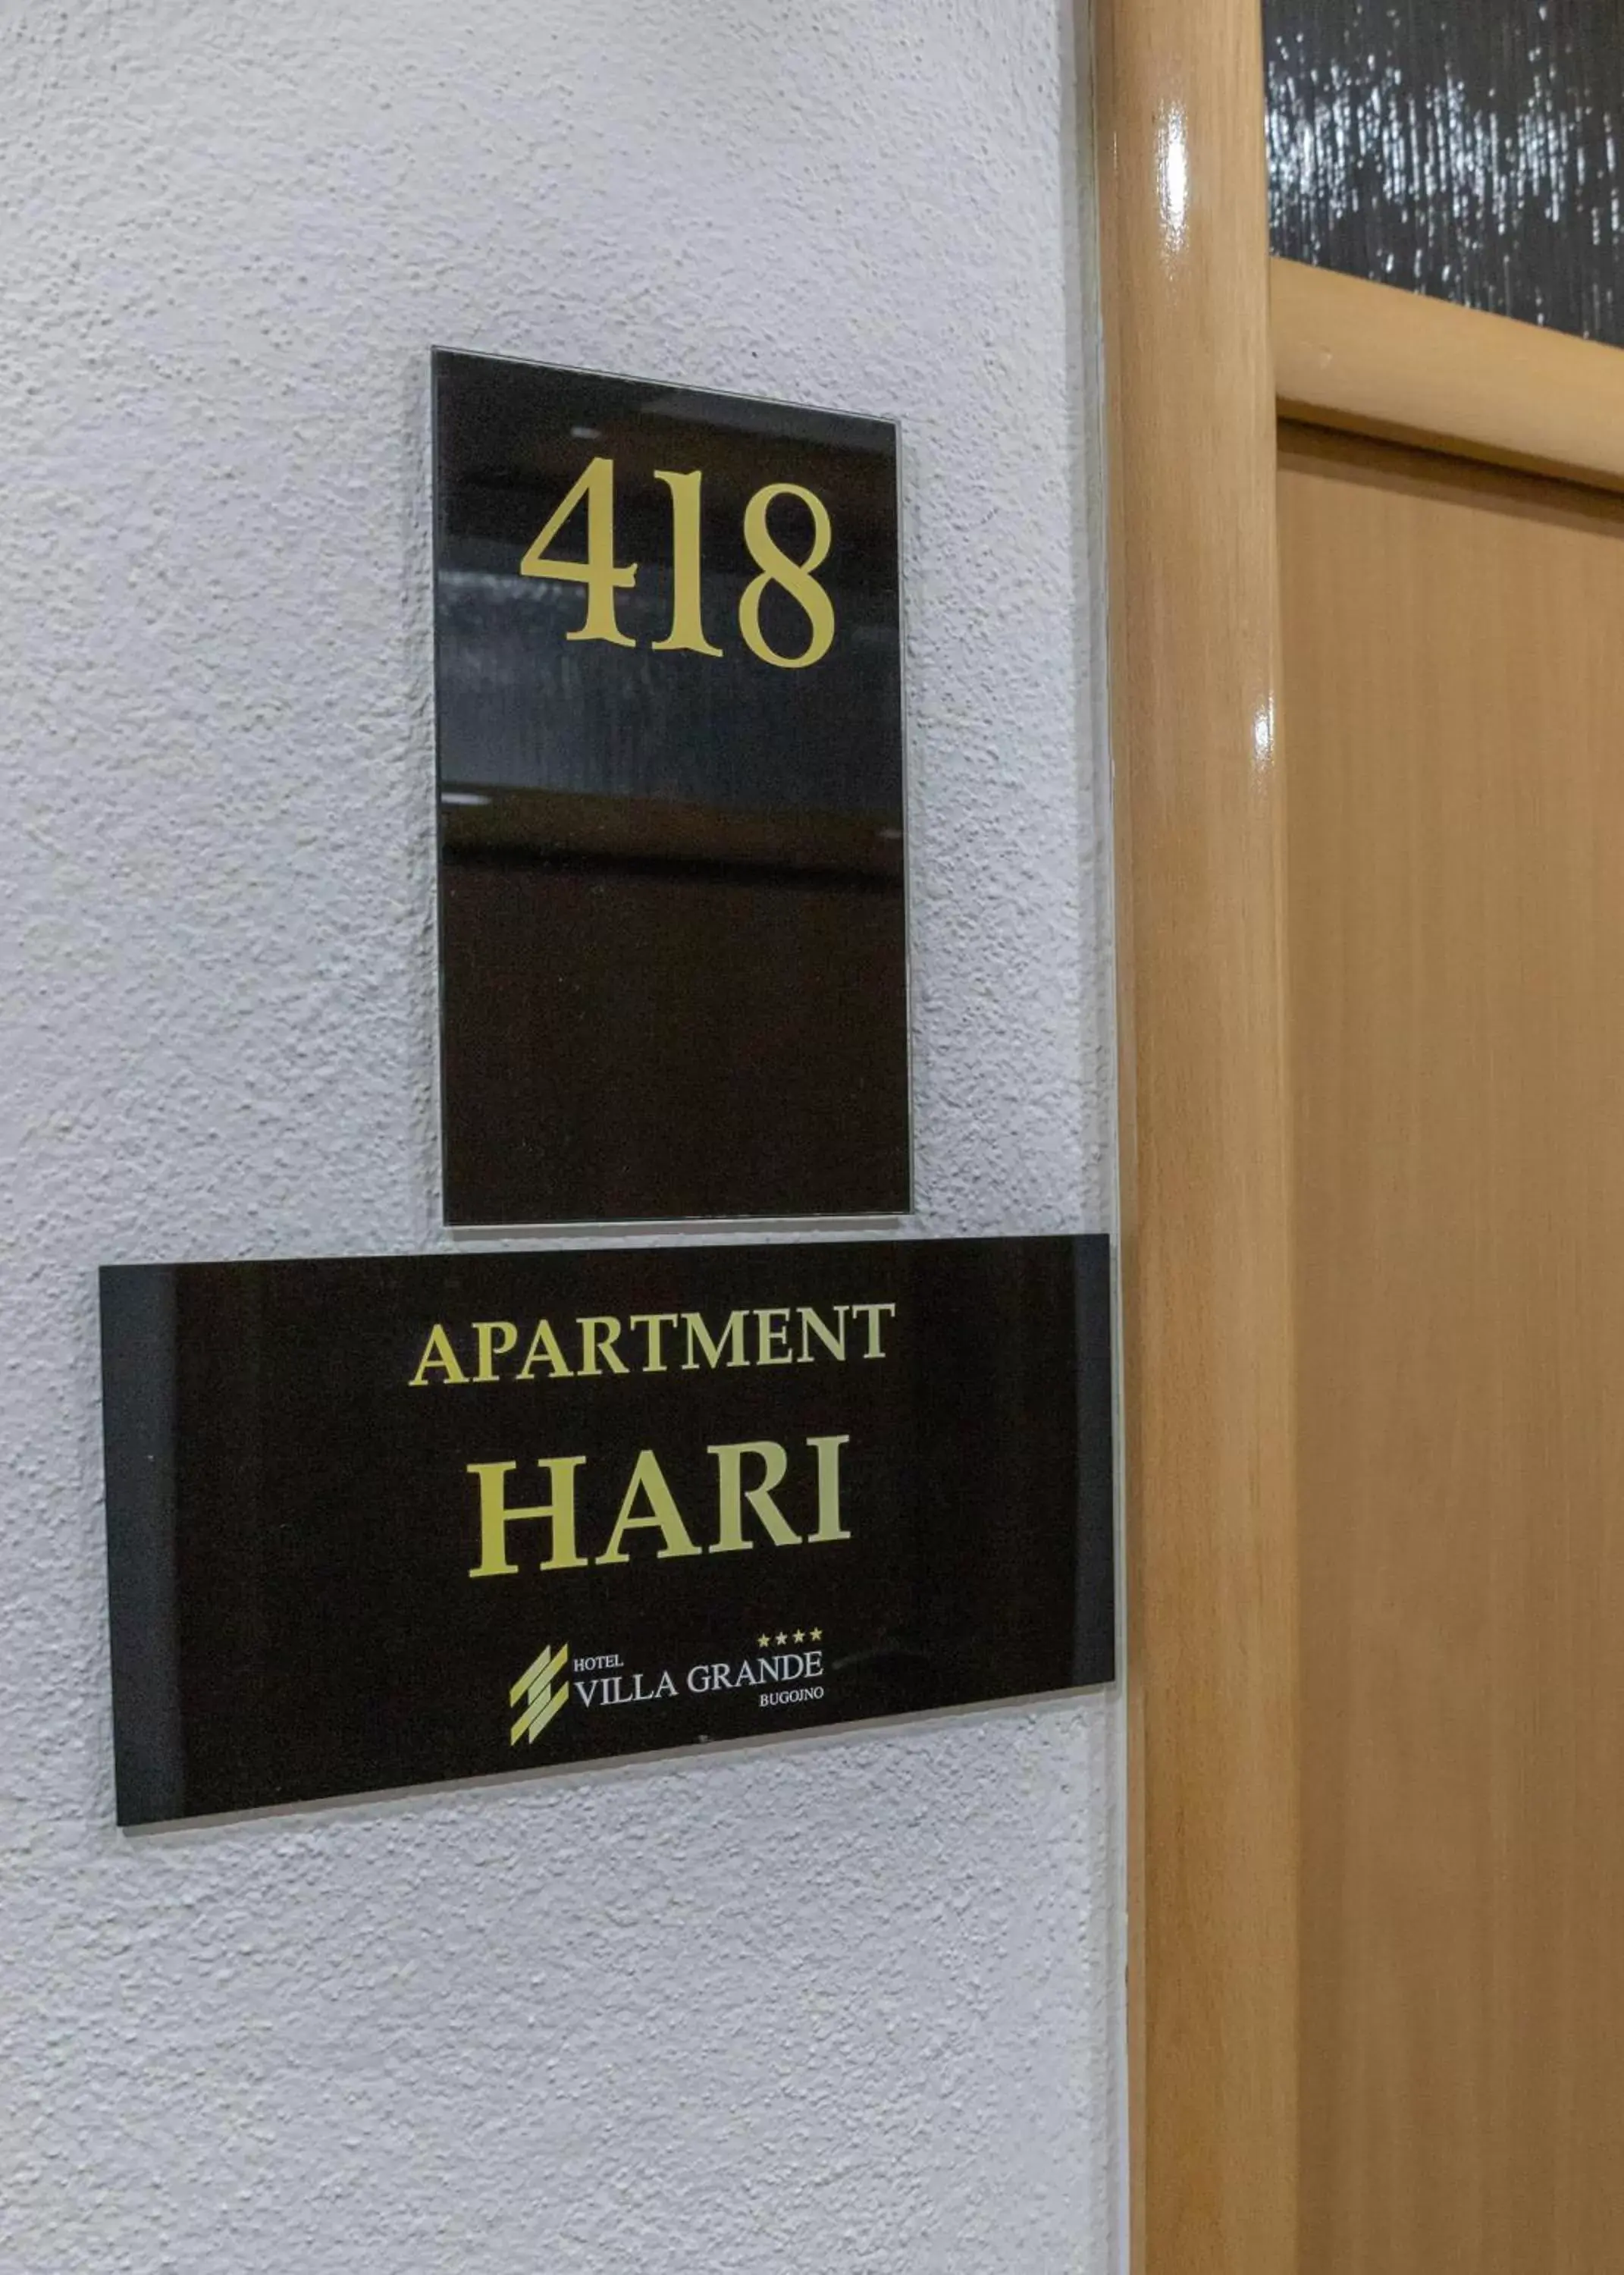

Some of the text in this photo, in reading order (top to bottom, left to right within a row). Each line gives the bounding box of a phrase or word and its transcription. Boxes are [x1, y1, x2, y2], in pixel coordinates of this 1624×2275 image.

[519, 457, 836, 669] 418
[408, 1302, 896, 1387] APARTMENT
[466, 1434, 851, 1579] HARI
[573, 1654, 624, 1672] HOTEL
[574, 1650, 824, 1708] VILLA GRANDE
[760, 1686, 825, 1707] BUGOJNO
